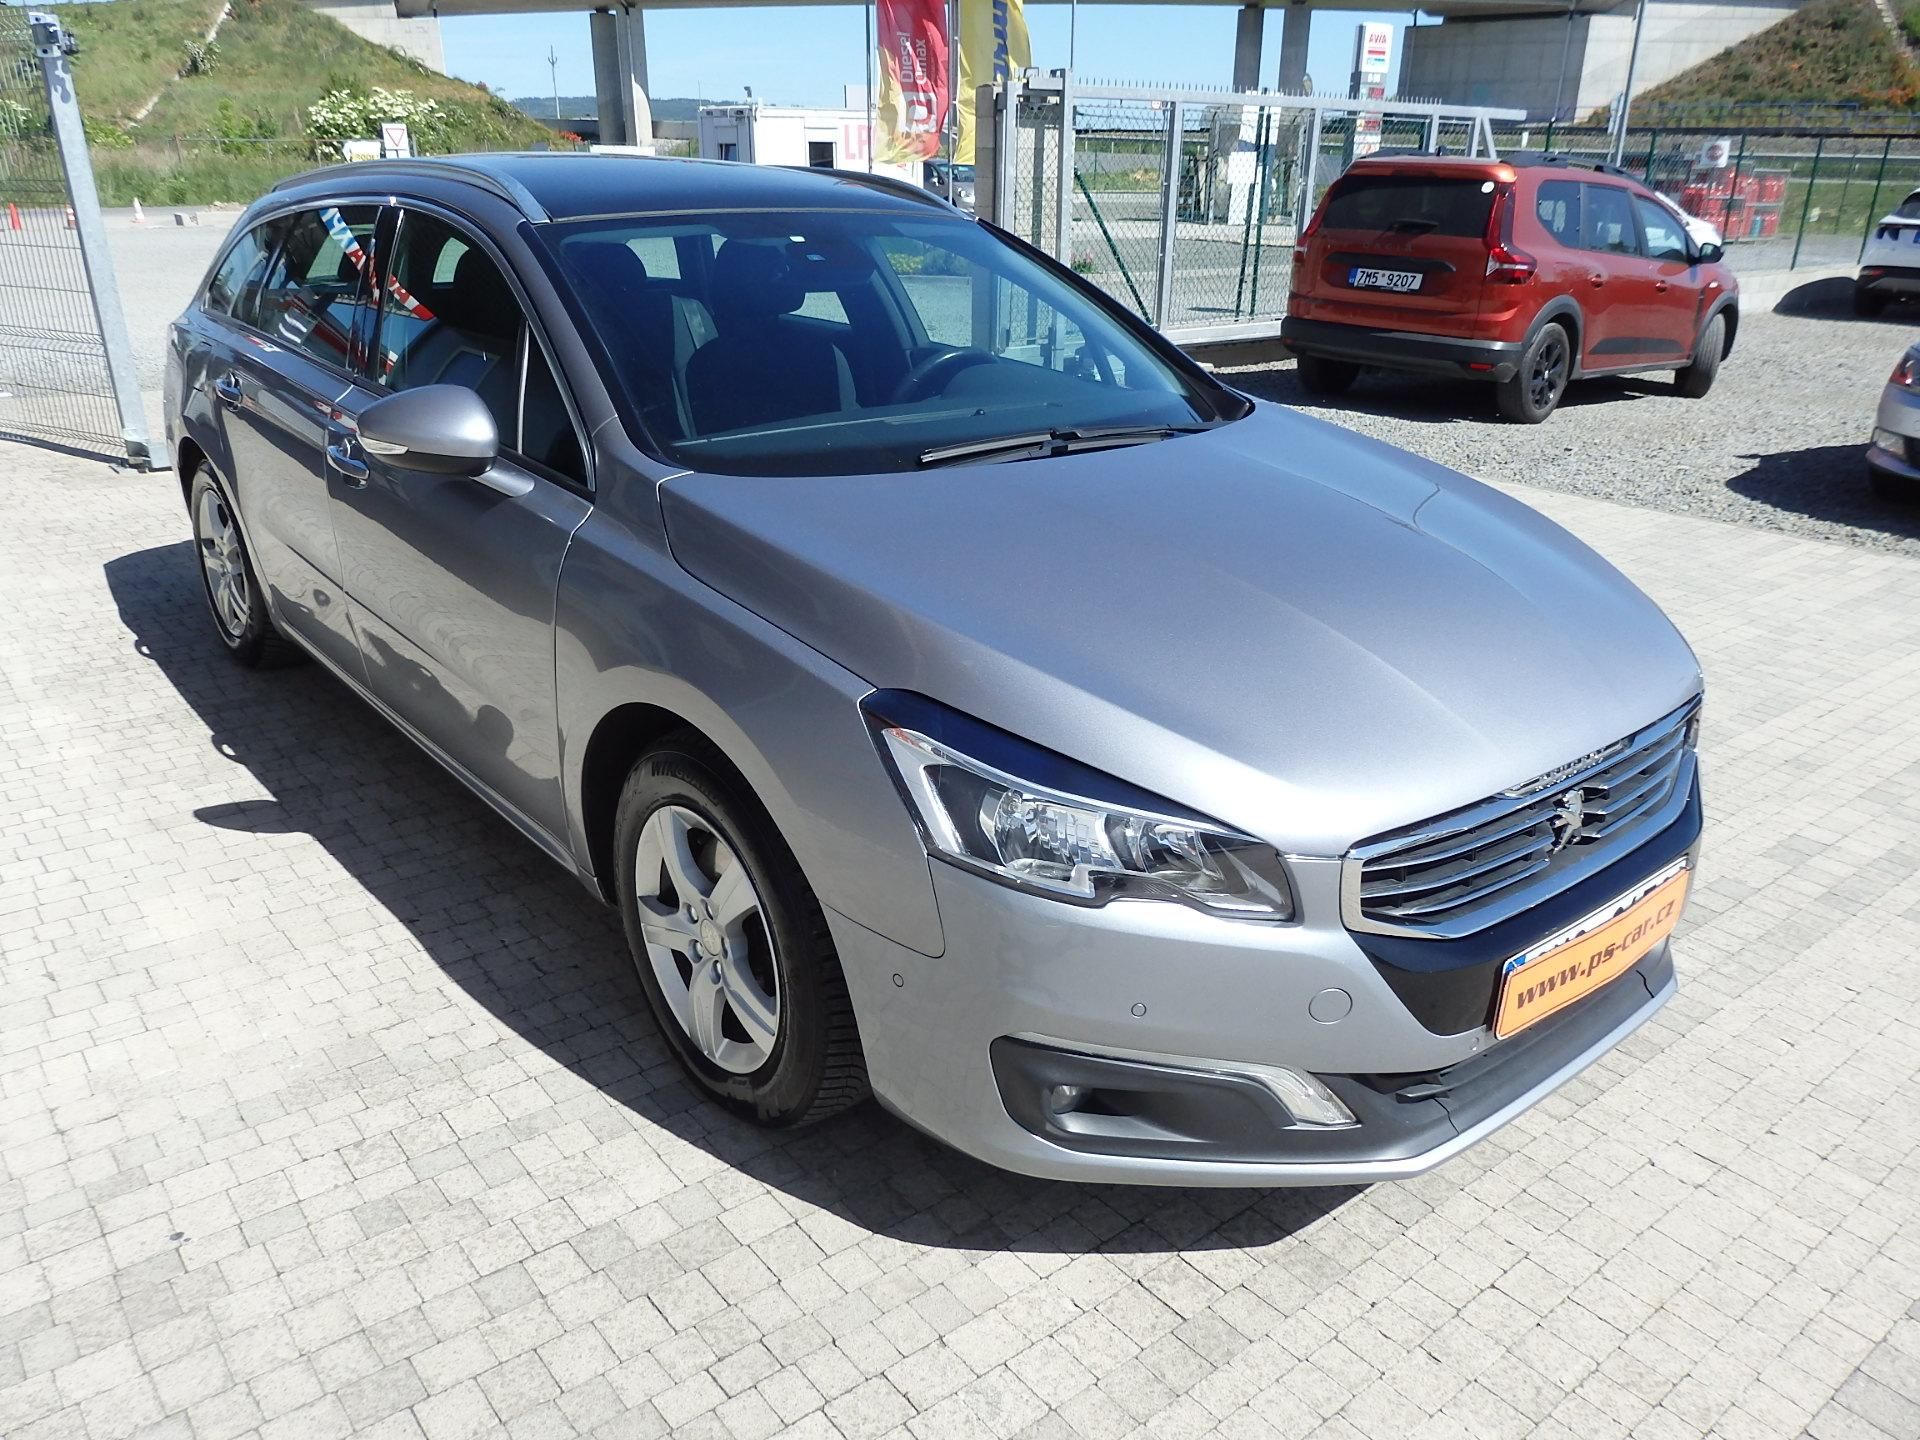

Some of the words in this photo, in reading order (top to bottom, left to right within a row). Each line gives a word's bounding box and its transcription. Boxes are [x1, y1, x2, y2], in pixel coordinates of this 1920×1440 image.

[897, 31, 914, 83] Diesel
[844, 124, 877, 160] LP
[1358, 270, 1379, 284] 7M5
[1387, 273, 1416, 288] 9207
[1517, 899, 1675, 1009] www.ps-car.cz
